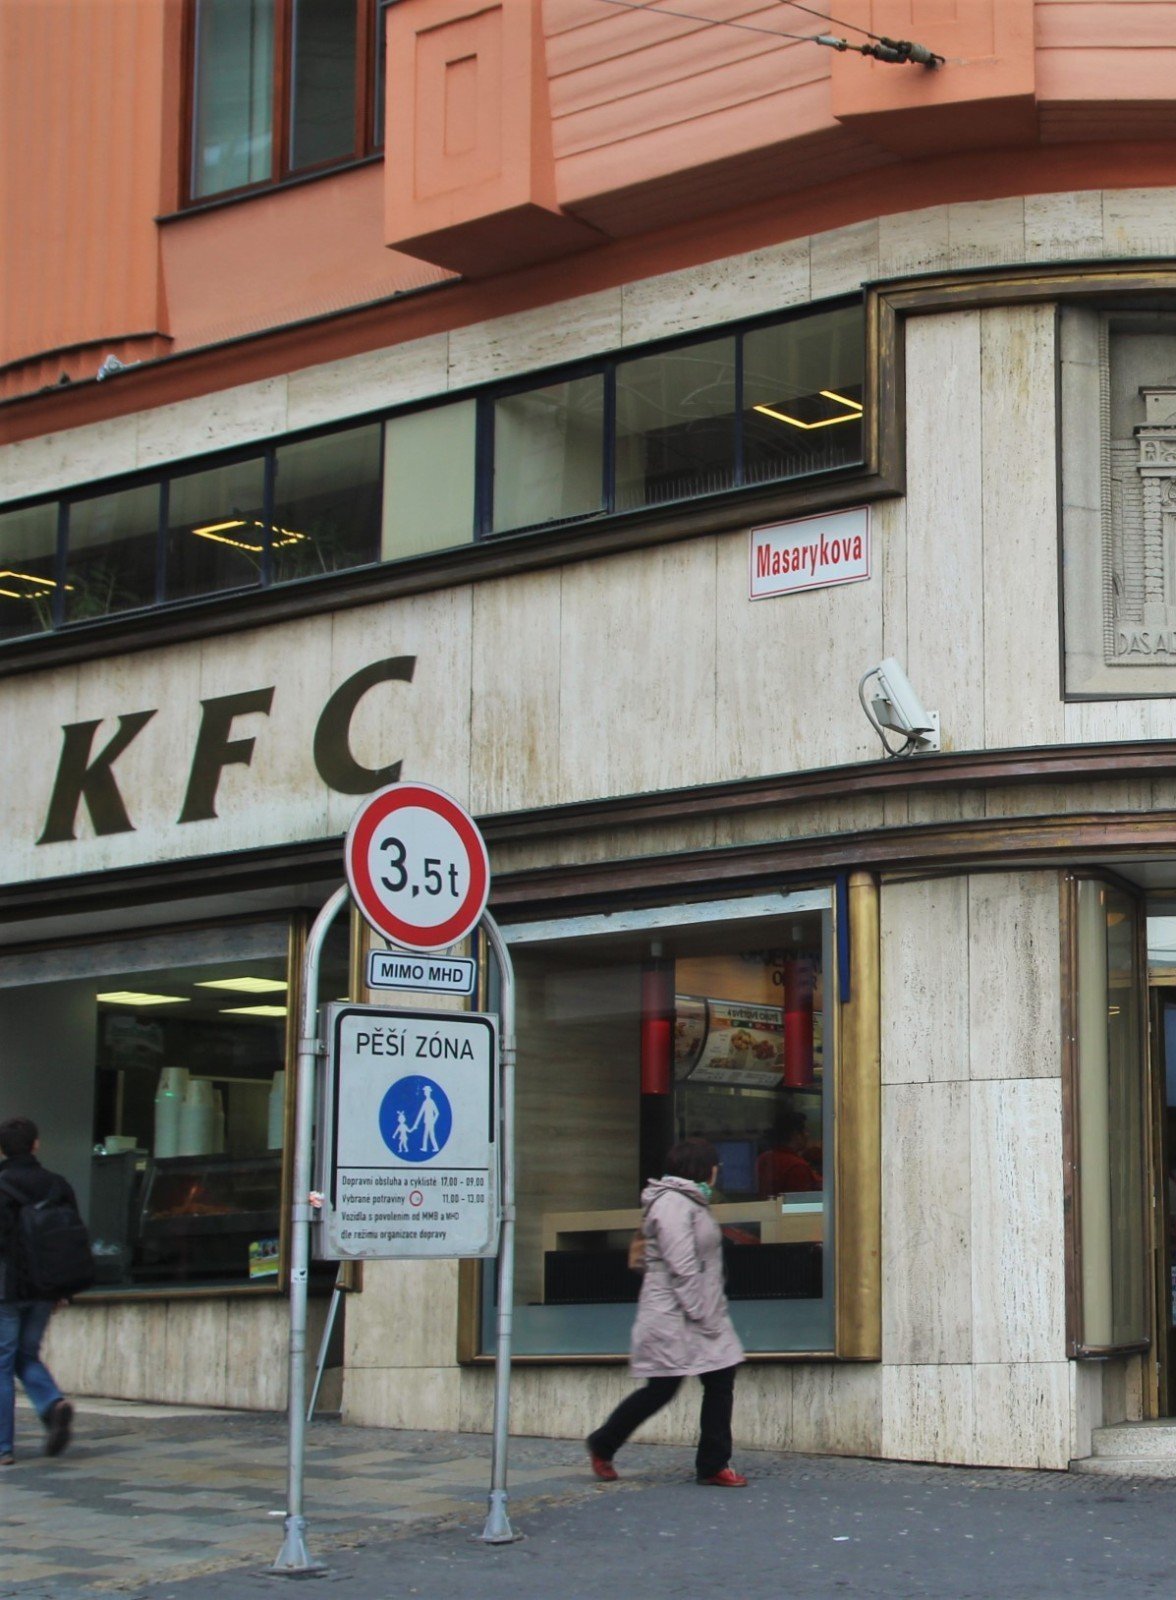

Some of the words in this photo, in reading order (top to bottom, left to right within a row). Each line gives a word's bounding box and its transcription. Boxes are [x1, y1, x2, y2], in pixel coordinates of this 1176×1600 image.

[757, 533, 862, 578] Masarykova
[1116, 632, 1149, 656] DAS
[35, 655, 417, 846] KFC
[381, 962, 424, 980] MIMO
[428, 966, 463, 983] MHD
[356, 1027, 407, 1056] PĚŠÍ
[415, 1031, 474, 1060] ZÓNA
[374, 1176, 402, 1186] obsluha
[404, 1178, 408, 1186] a
[441, 1176, 458, 1187] 17.00
[412, 1212, 420, 1220] od
[422, 1212, 438, 1220] MMB
[340, 1230, 352, 1239] dle
[420, 1229, 446, 1240] dopravy
